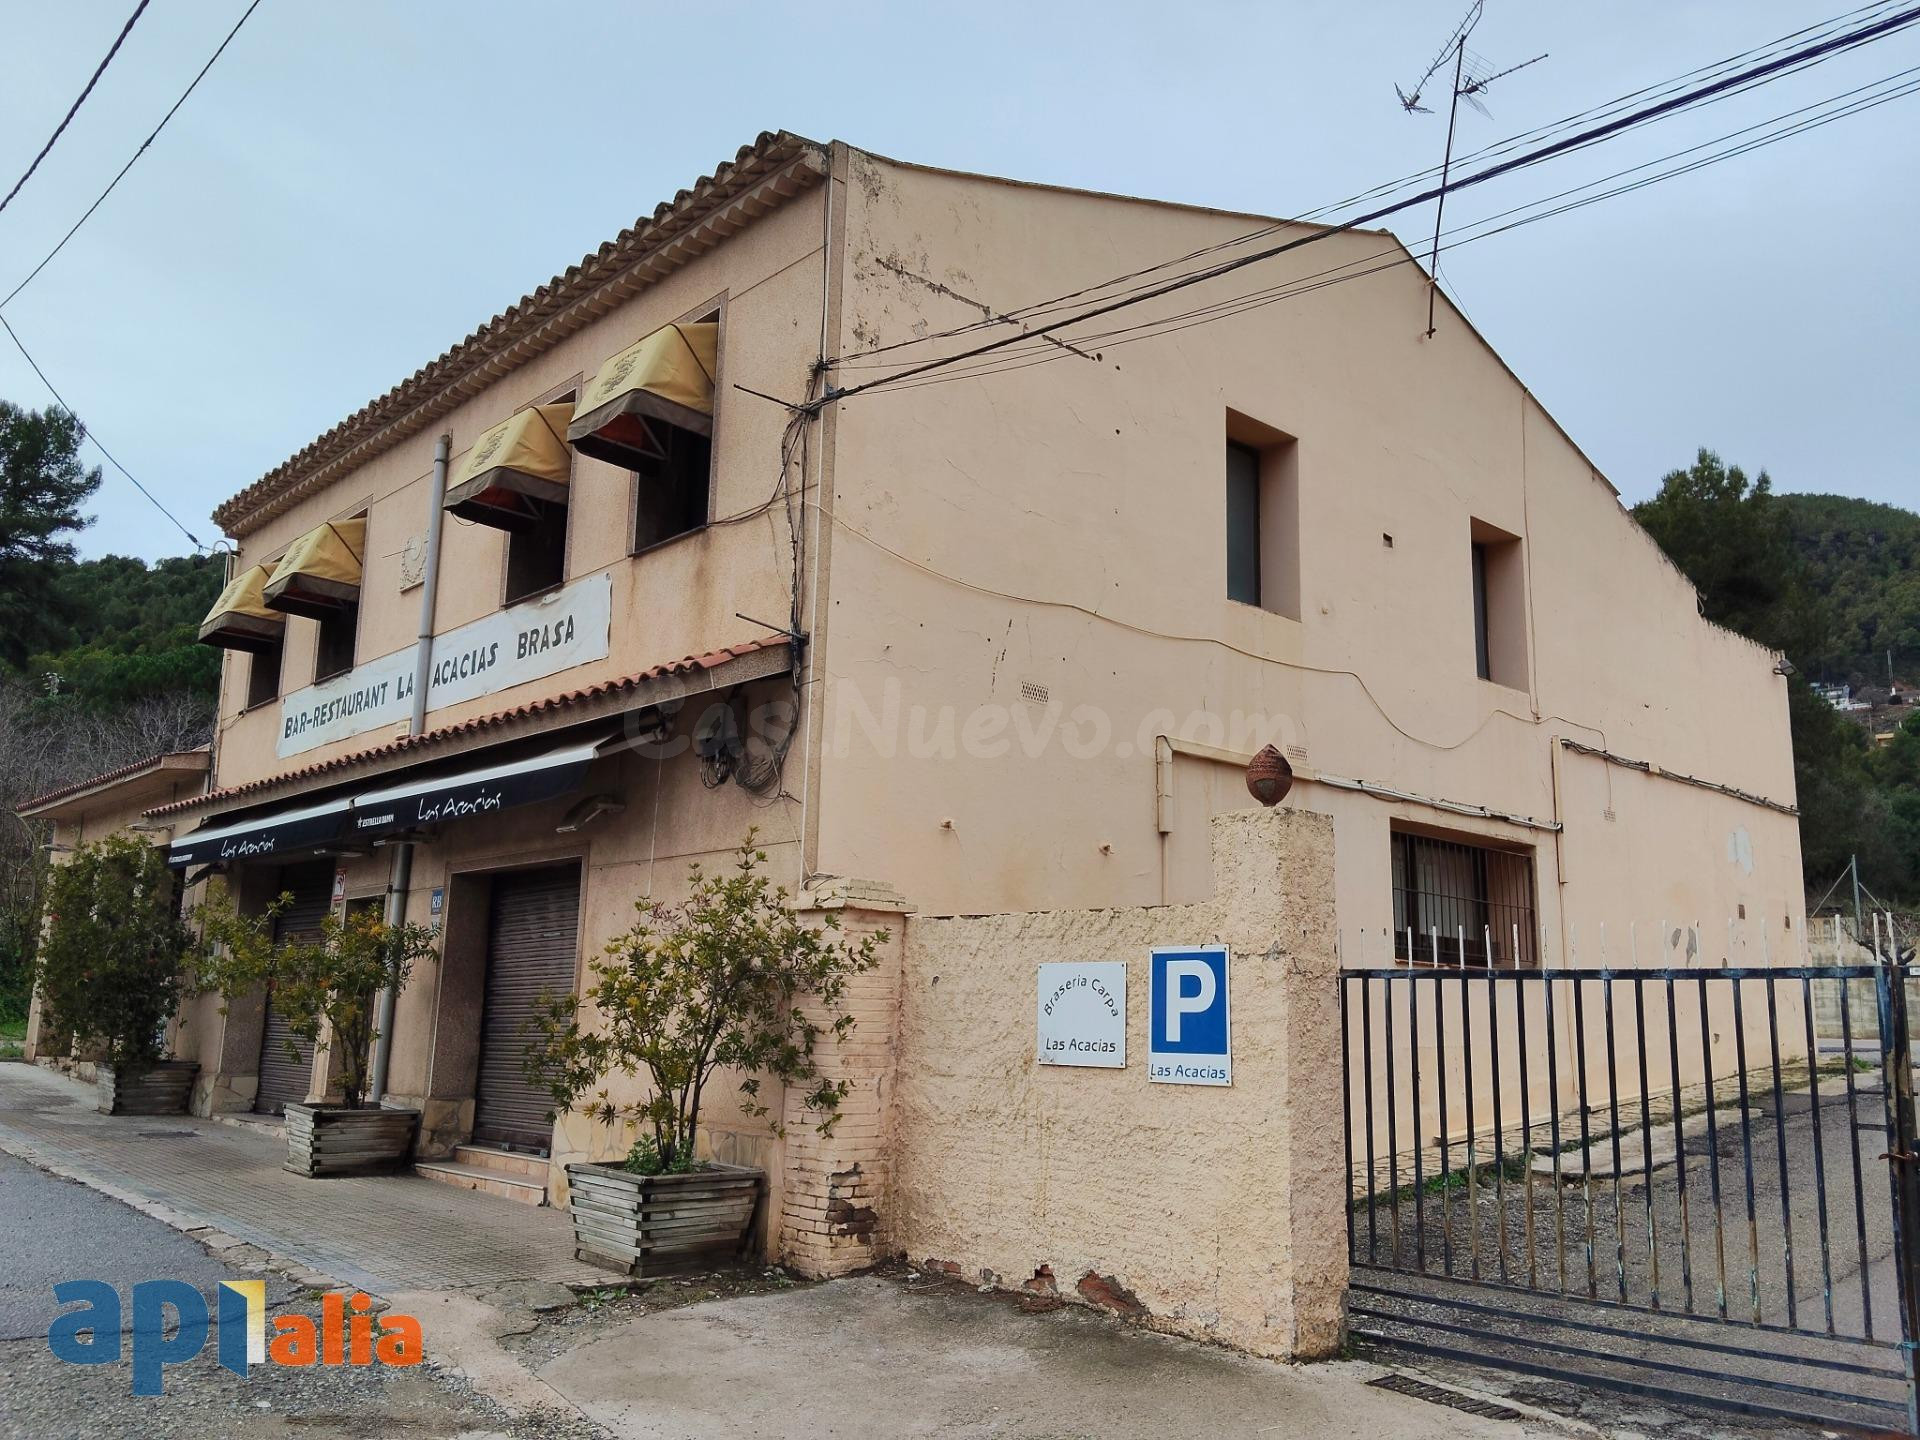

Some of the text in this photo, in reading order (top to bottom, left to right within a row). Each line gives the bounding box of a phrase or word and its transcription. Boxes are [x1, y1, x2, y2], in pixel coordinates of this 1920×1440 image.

[284, 681, 388, 739] BAR-RESTAURANT
[432, 643, 499, 688] ACACIAS
[516, 614, 574, 660] BRASA
[418, 798, 440, 820] Las
[1044, 974, 1119, 1018] Braseria Carpa
[1165, 959, 1216, 1042] P
[1046, 1037, 1116, 1053] Las Acacias
[1150, 1063, 1226, 1079] Las Acacias
